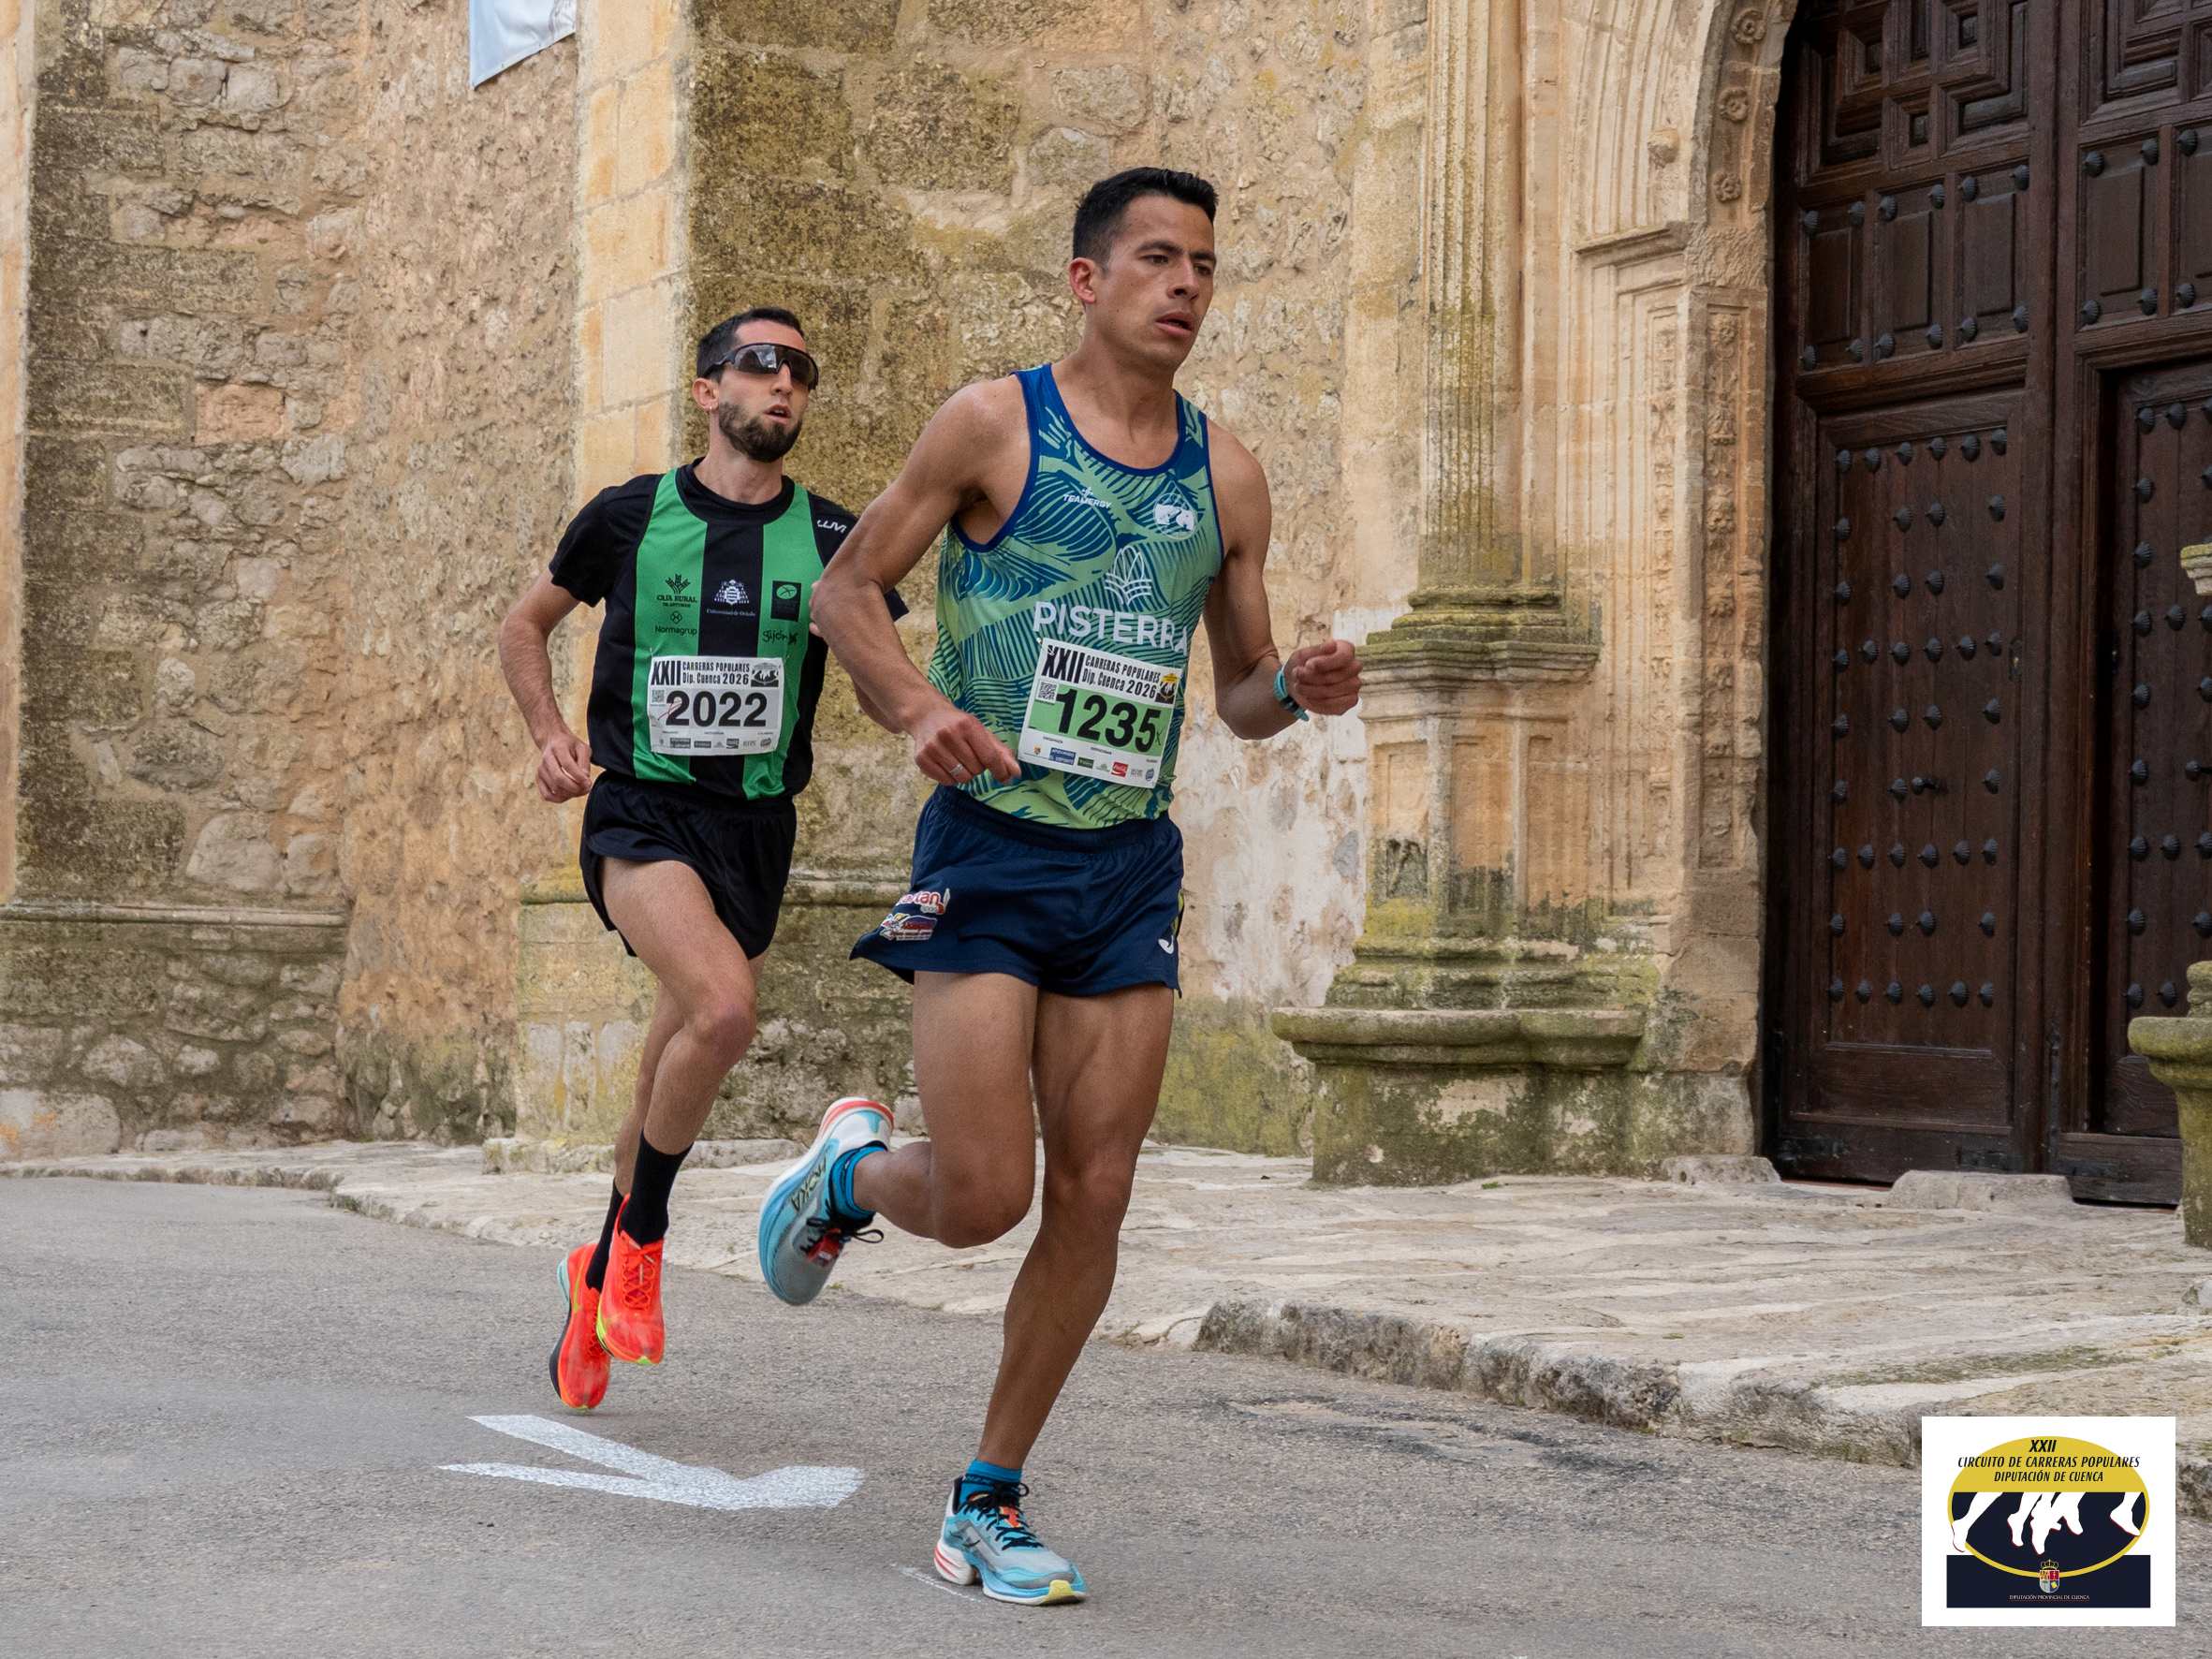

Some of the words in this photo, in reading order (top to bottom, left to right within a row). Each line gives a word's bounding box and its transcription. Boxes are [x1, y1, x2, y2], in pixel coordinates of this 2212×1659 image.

[655, 625, 697, 637] Normagrup
[651, 660, 681, 685] XXII
[682, 662, 713, 671] CARRERAS
[716, 663, 750, 672] POPULARES
[696, 672, 721, 684] Cuenca
[723, 674, 749, 684] 2026
[1041, 645, 1085, 684] XXII
[1085, 655, 1121, 674] CARRERAS
[1121, 664, 1161, 683] POPULARES
[1097, 671, 1125, 691] Cuenca
[1126, 680, 1157, 698] 2026
[666, 690, 768, 727] 2022
[1056, 688, 1162, 753] 1235
